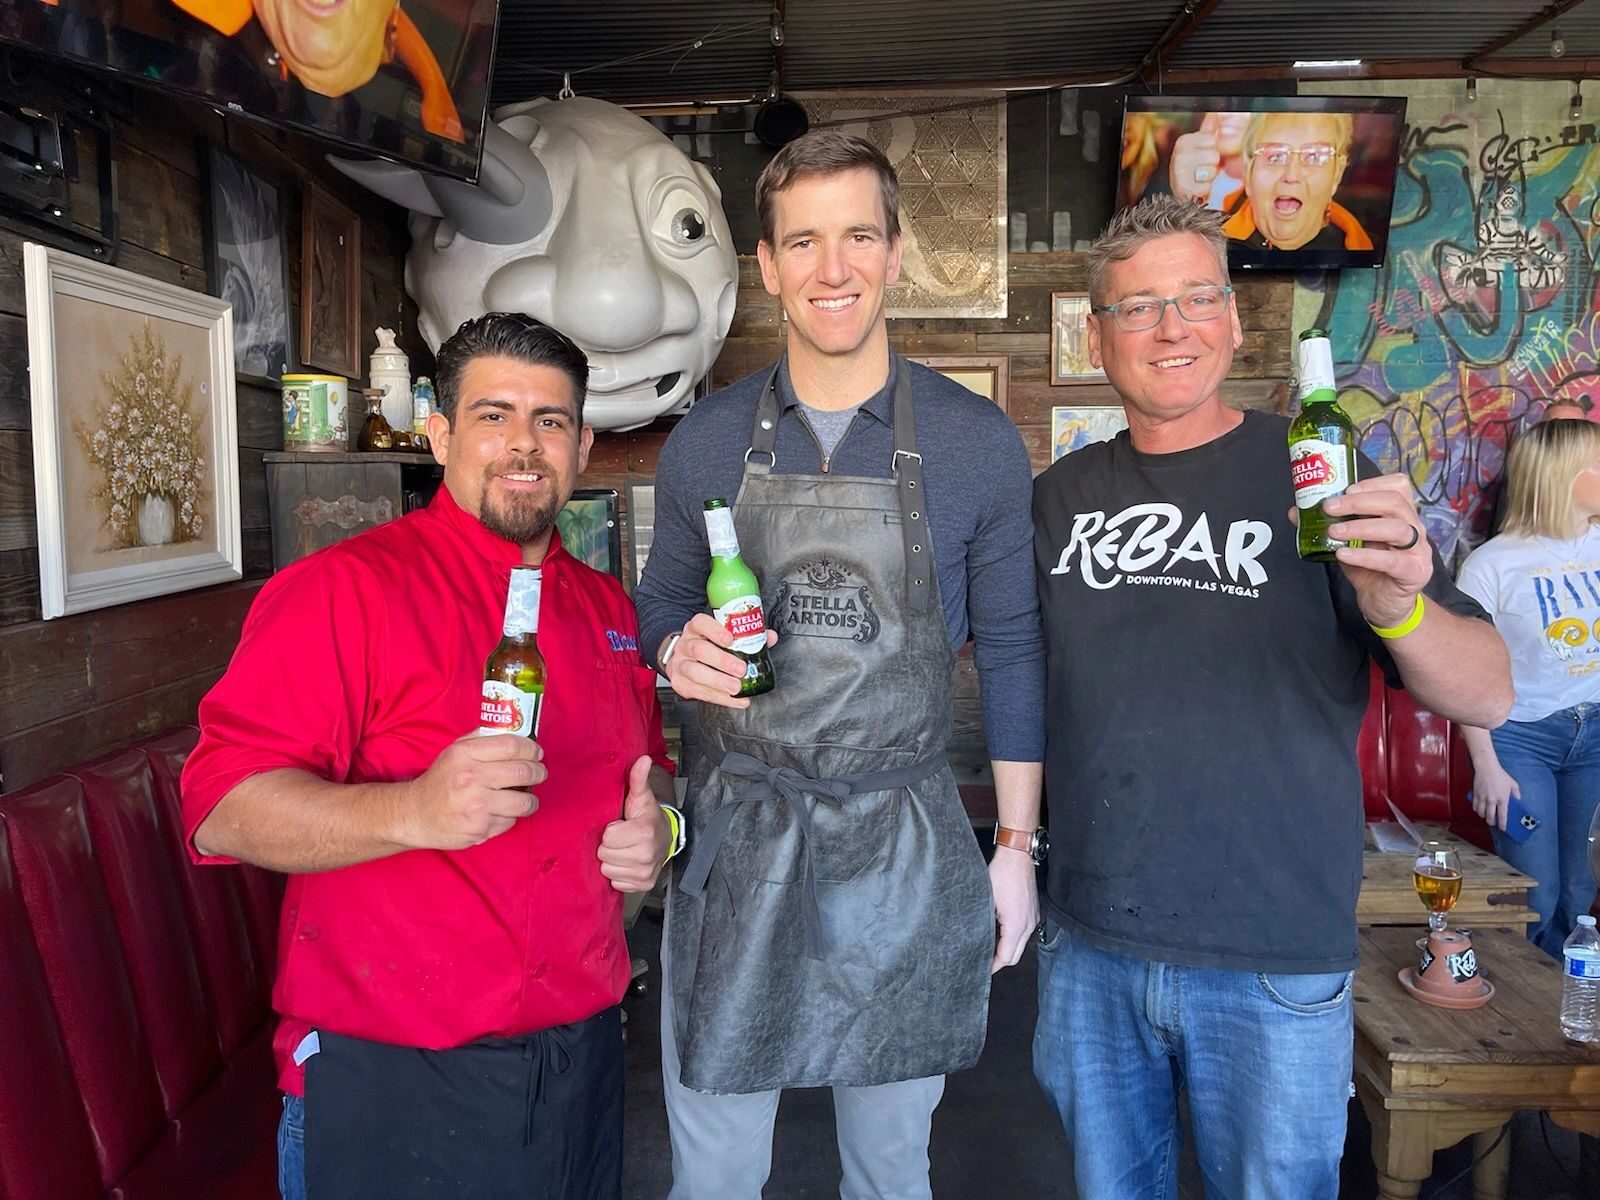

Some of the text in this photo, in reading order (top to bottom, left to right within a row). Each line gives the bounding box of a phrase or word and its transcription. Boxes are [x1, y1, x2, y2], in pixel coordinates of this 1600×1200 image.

[1126, 575, 1260, 598] DOWNTOWN LAS VEGAS
[790, 595, 857, 612] STELLA
[731, 613, 762, 626] STELLA
[732, 620, 763, 635] ARTOIS
[788, 611, 858, 628] ARTOIS
